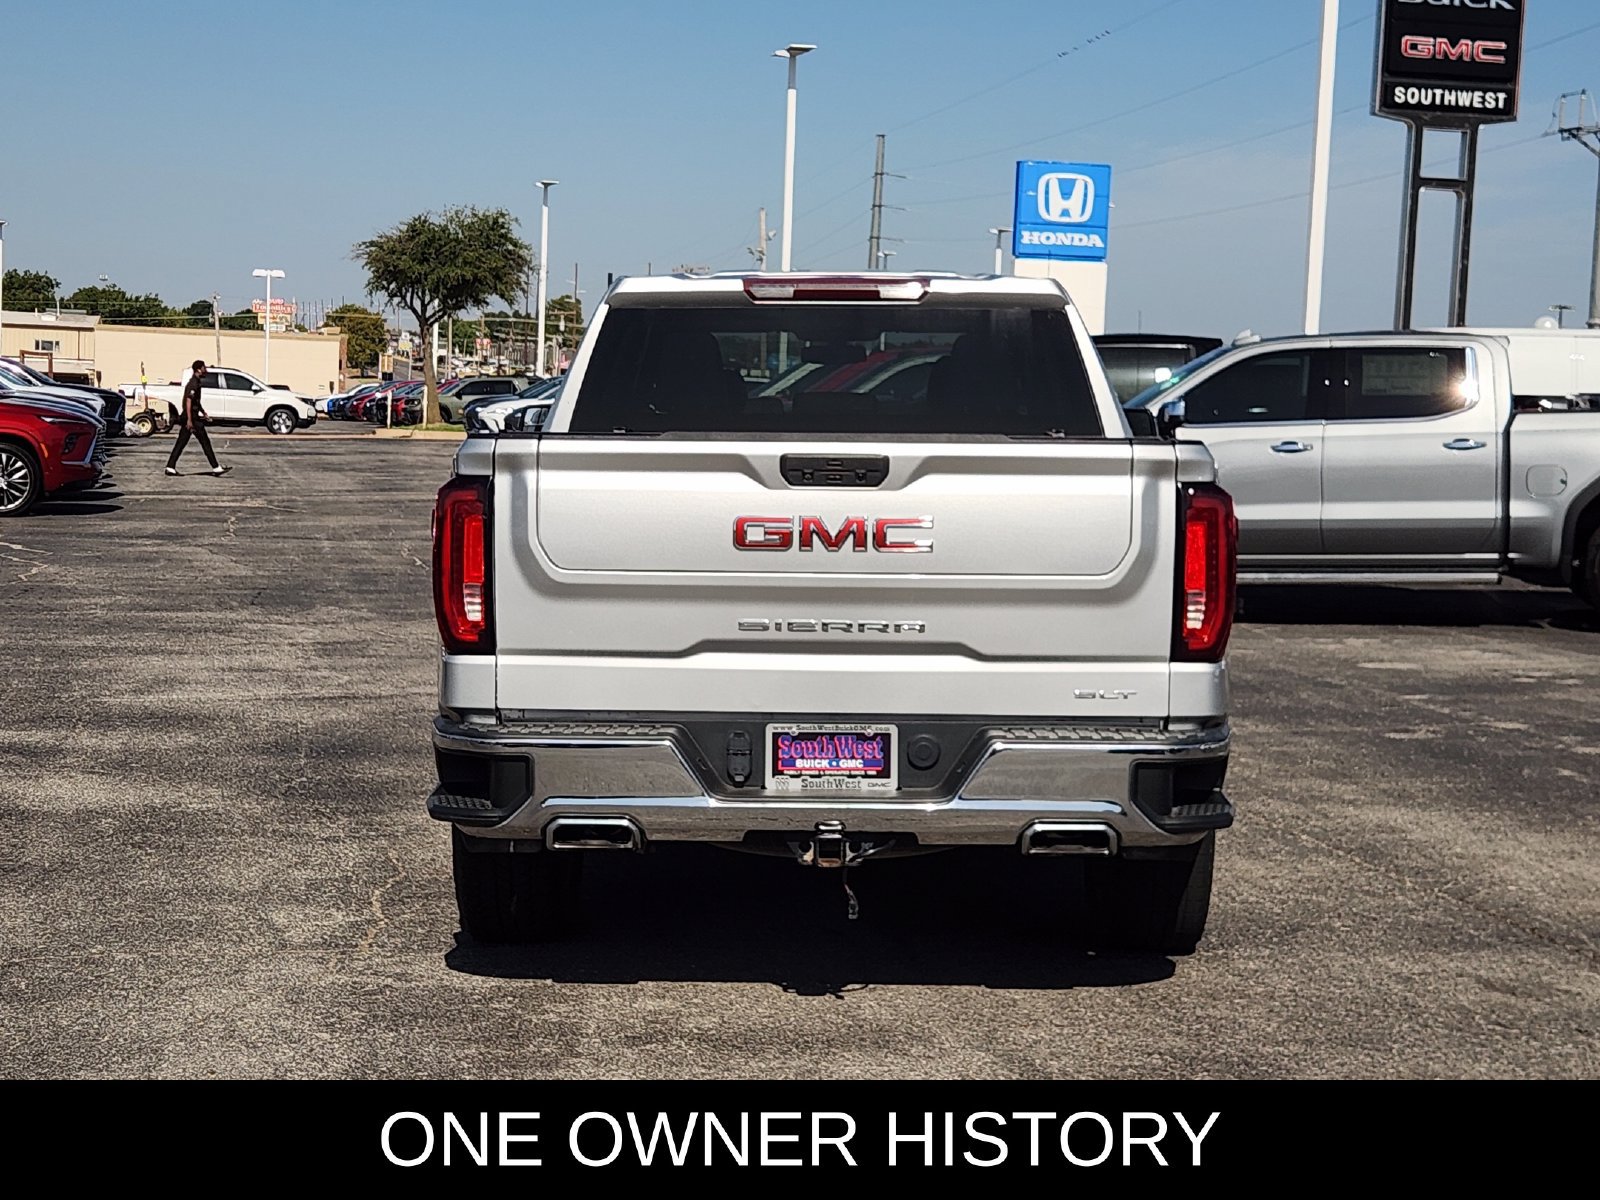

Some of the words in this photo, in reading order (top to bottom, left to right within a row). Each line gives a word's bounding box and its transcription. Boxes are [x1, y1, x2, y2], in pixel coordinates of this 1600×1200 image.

[1401, 35, 1507, 64] GMC
[1394, 87, 1507, 109] SOUTHWEST
[1021, 230, 1105, 248] HONDA
[733, 515, 933, 552] GMC
[738, 618, 926, 633] SIERRA
[1073, 689, 1137, 699] SLT
[778, 734, 883, 758] SouthWest
[795, 759, 829, 768] BUICK
[839, 759, 864, 768] GMC
[801, 778, 862, 789] SouthWest
